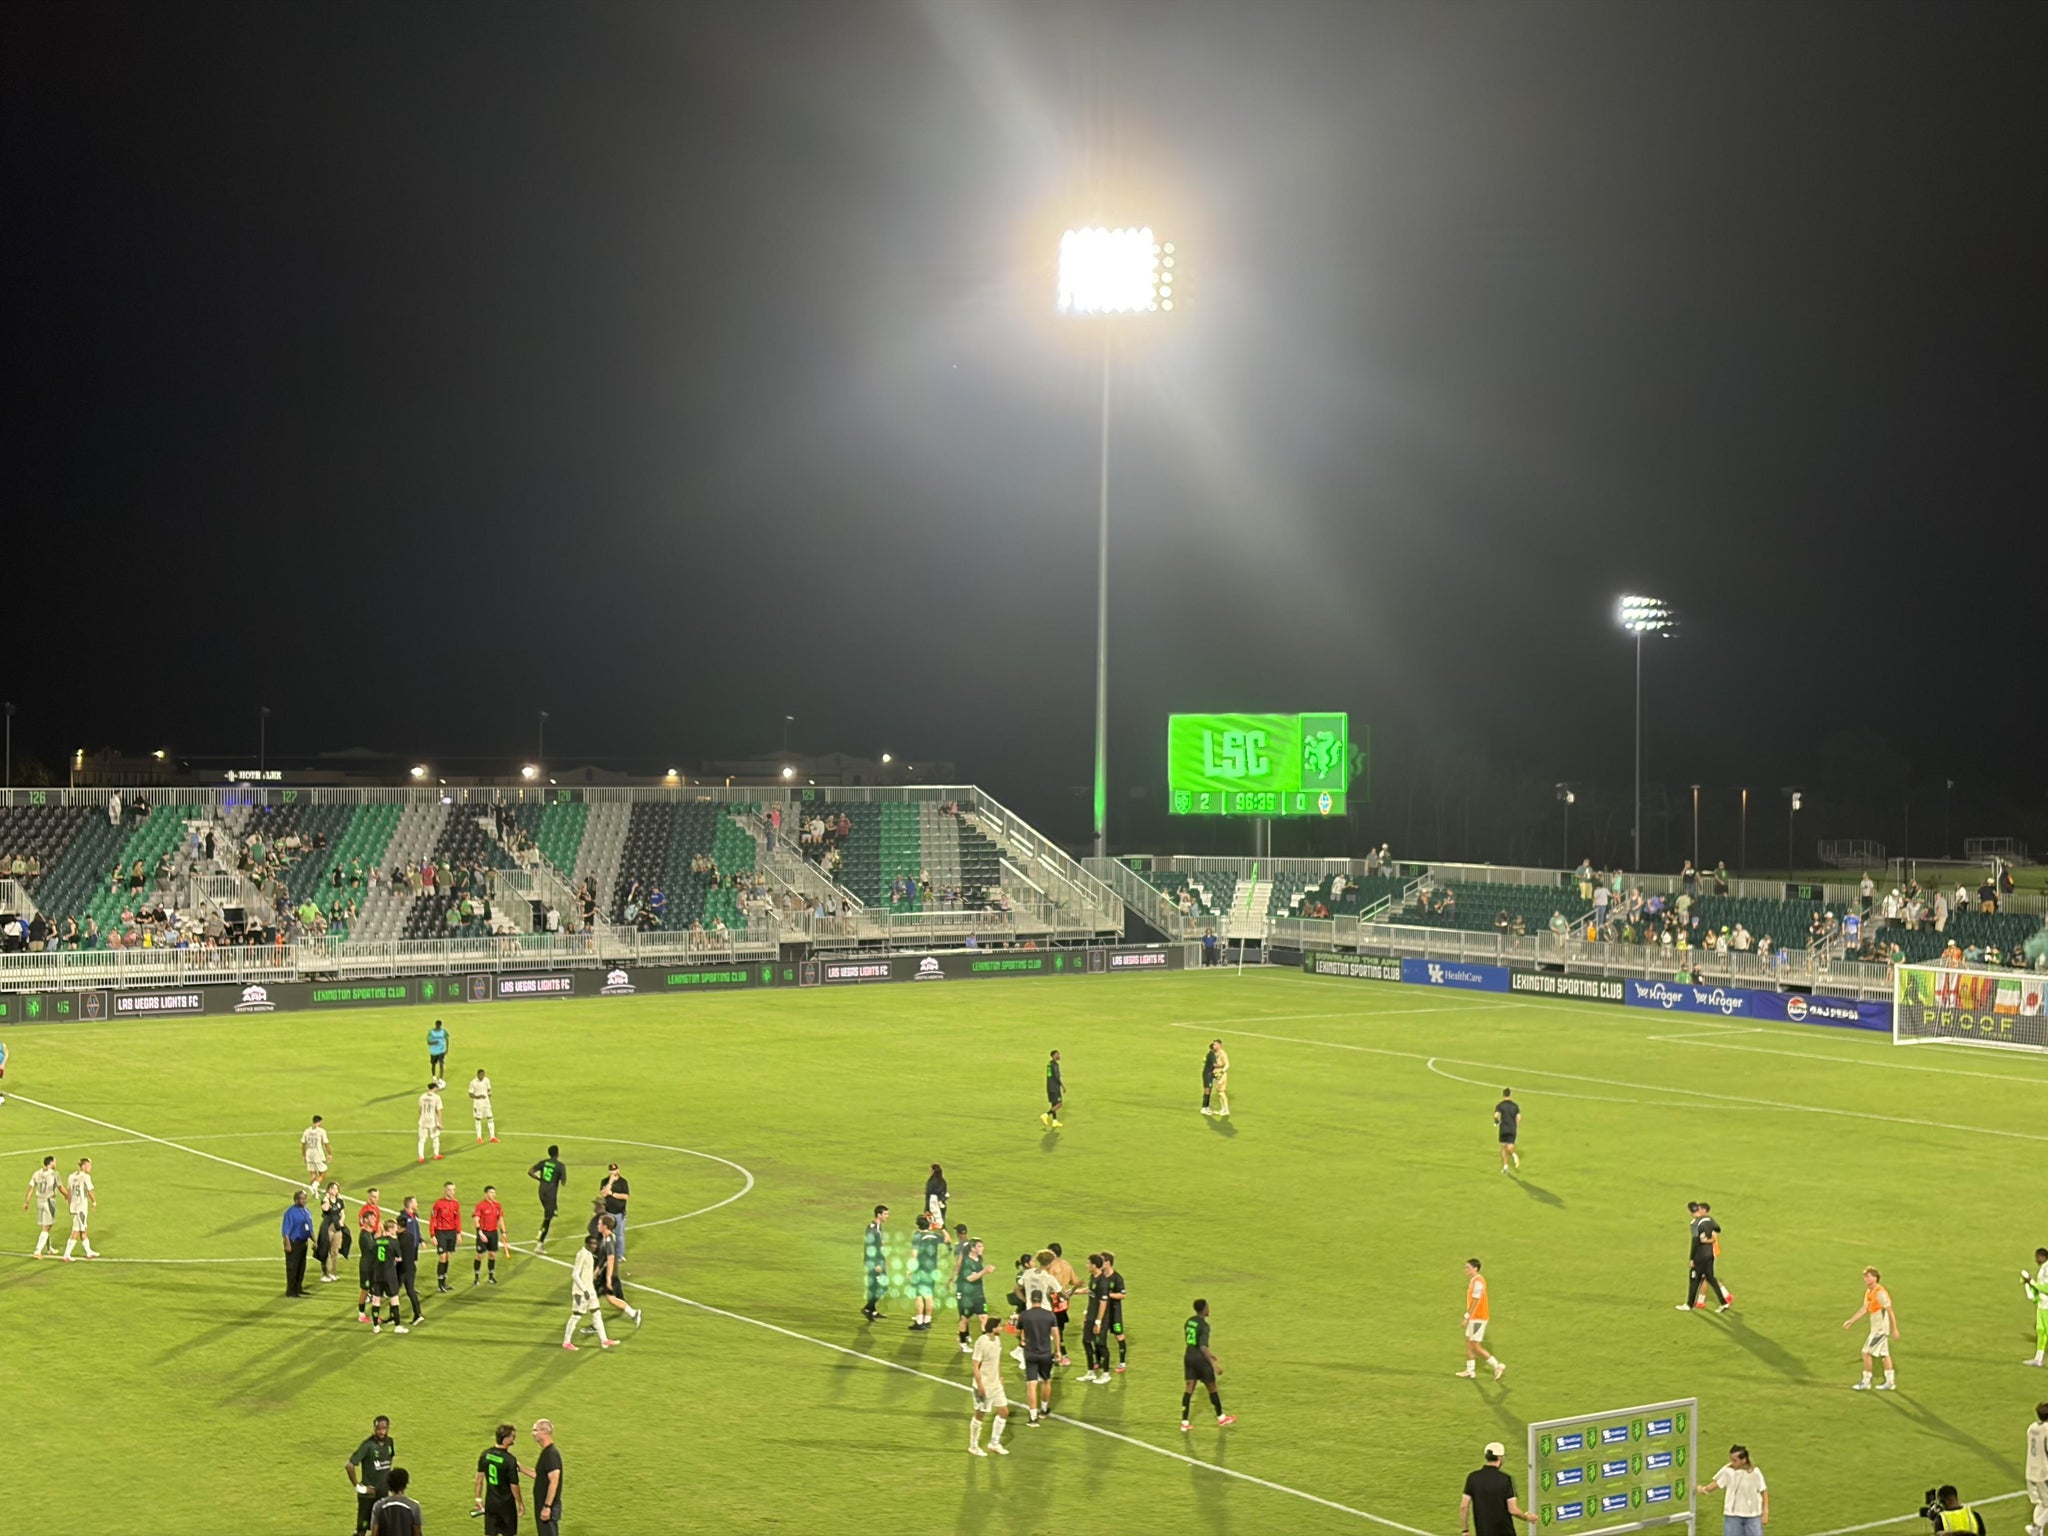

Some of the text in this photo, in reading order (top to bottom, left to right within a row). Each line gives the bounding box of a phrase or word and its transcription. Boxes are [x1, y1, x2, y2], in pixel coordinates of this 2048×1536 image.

[1203, 729, 1270, 777] LSC
[282, 790, 298, 803] 127
[1200, 793, 1211, 810] 2
[1028, 960, 1042, 969] CLUB
[1112, 956, 1122, 966] LAS
[1140, 954, 1156, 964] LIGHTS
[701, 972, 730, 984] SPORTING
[731, 970, 747, 982] CLUB
[828, 966, 888, 978] LAS VEGAS LIGHTS FC
[1316, 960, 1400, 980] LEXINGTON SPORTING CLUB
[1445, 970, 1483, 983] HealthCare
[501, 978, 570, 993] LAS VEGAS LIGHTS FC
[1512, 973, 1622, 1000] LEXINGTON SPORTING CLUB
[314, 986, 406, 1002] LEXINGTON SPORTING CLUB
[1650, 983, 1683, 1009] Kroger
[1709, 988, 1743, 1015] Kroger
[118, 995, 198, 1010] LAS VEGAS LIGHTS FC
[1924, 1010, 2015, 1033] PROOF
[544, 1166, 554, 1182] 15
[378, 1246, 386, 1262] 6
[489, 1464, 498, 1486] 9
